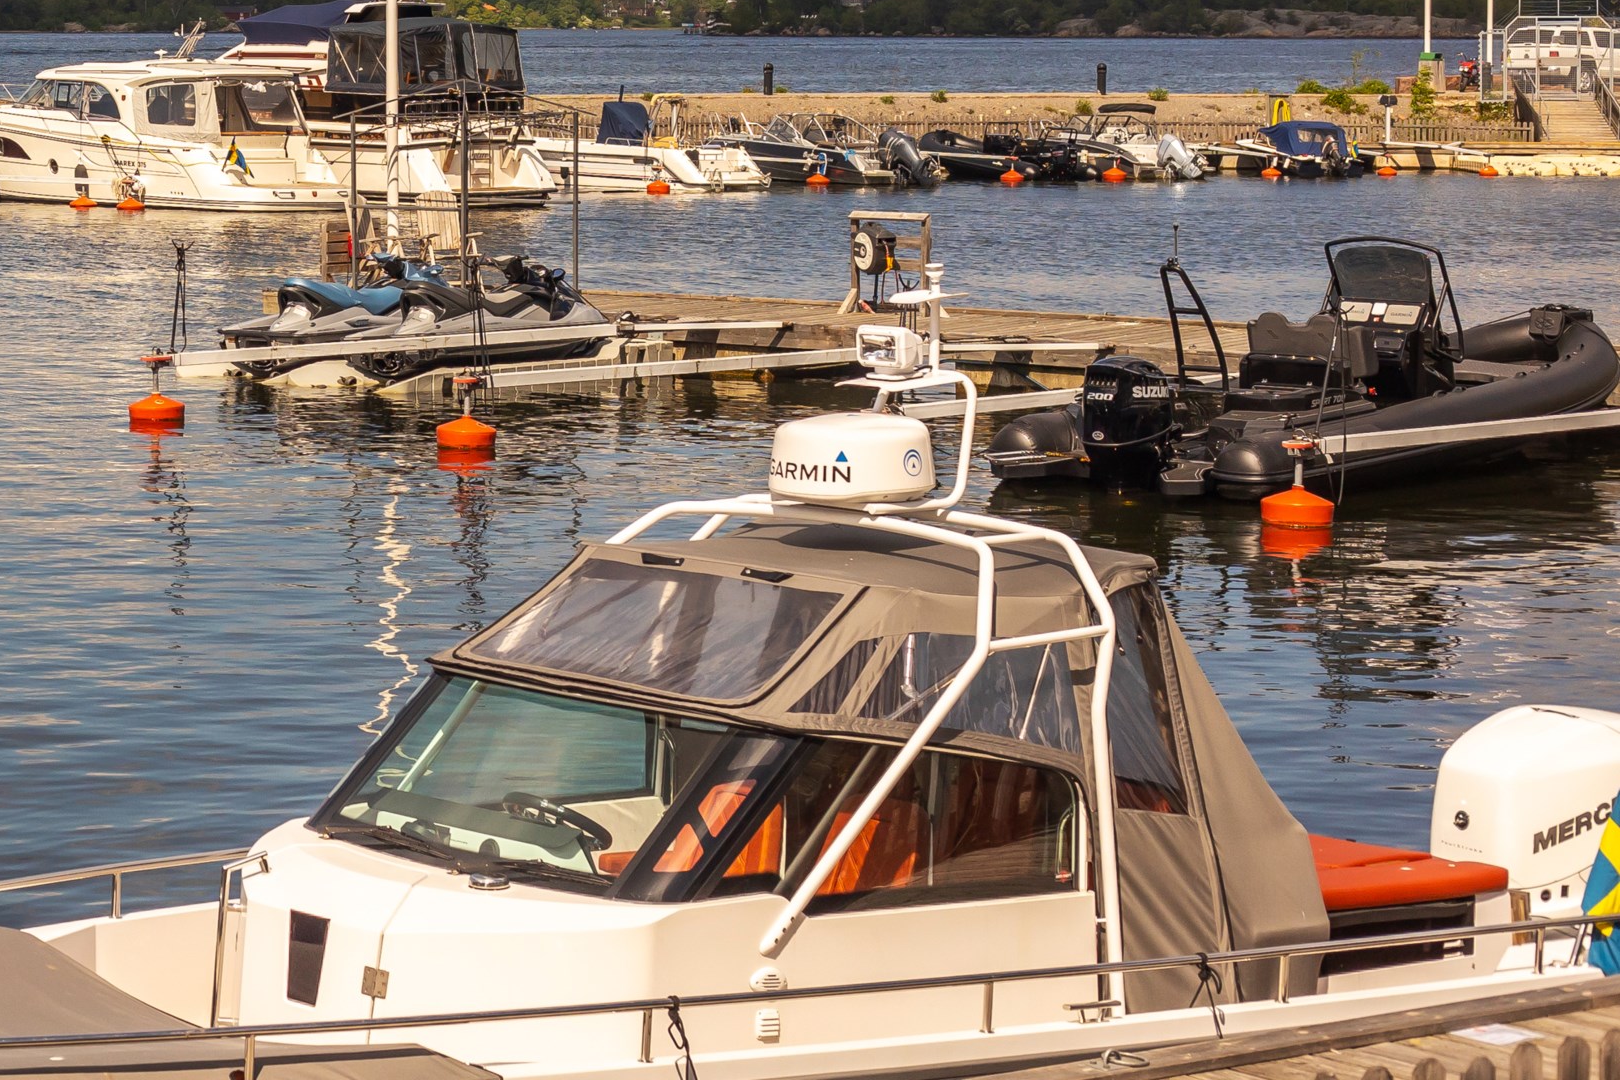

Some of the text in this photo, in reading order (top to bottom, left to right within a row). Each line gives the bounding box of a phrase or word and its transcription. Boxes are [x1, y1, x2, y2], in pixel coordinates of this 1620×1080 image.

[1087, 392, 1114, 401] 200
[770, 458, 851, 483] GARMIN
[1533, 796, 1617, 855] MERC
